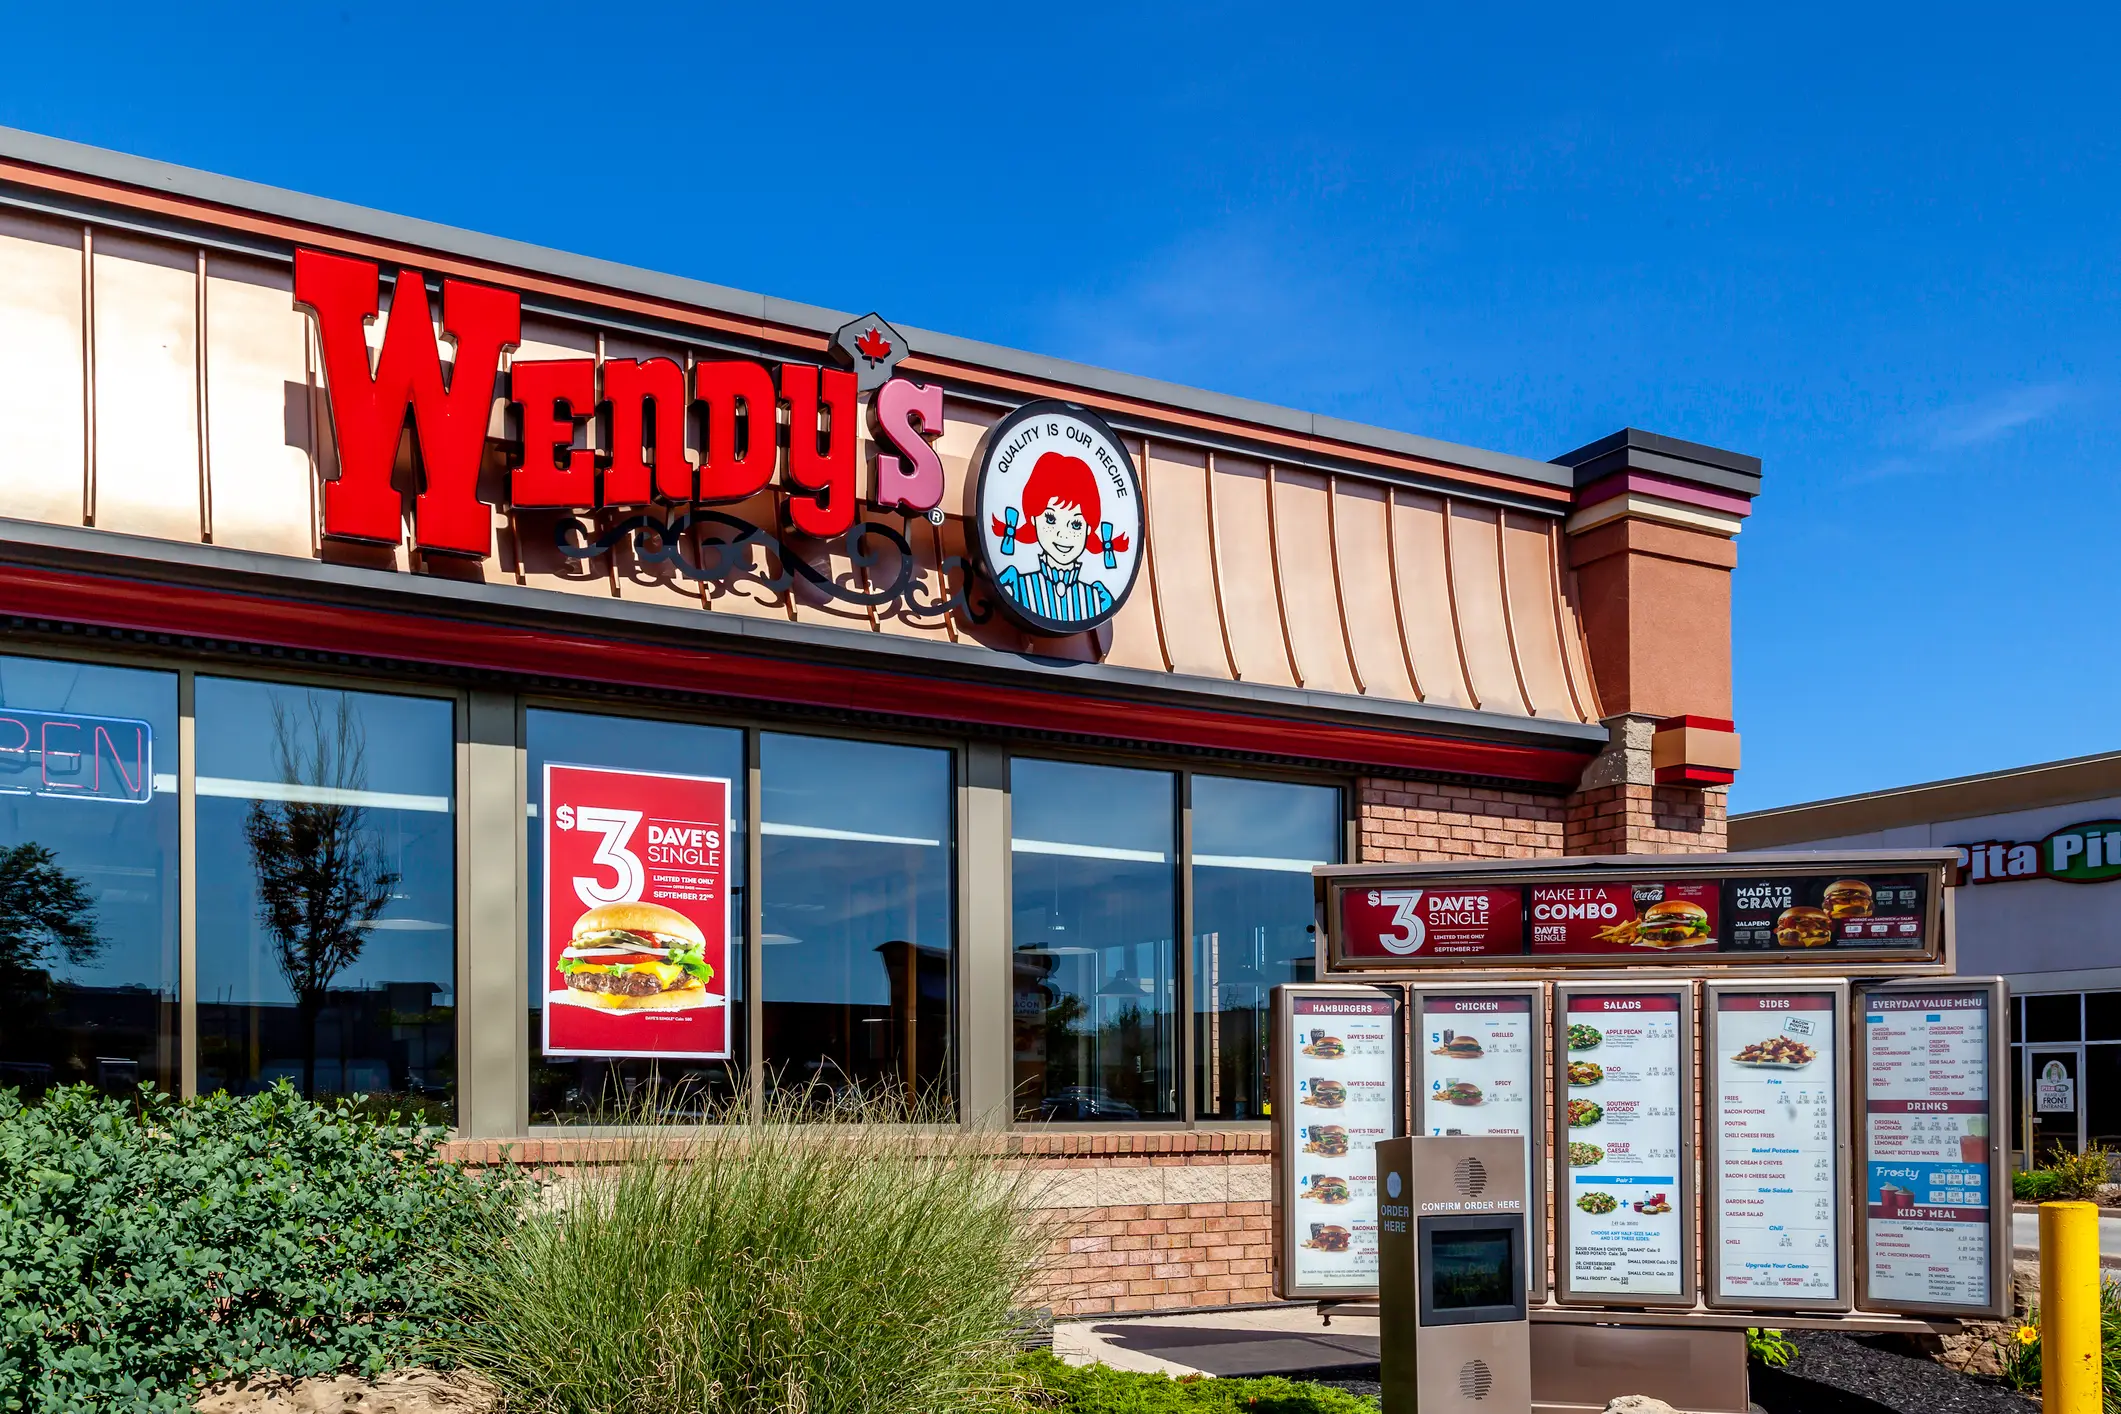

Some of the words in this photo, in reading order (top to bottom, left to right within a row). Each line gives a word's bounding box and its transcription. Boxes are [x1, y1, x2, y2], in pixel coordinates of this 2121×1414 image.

[998, 426, 1041, 473] QUALITY
[1046, 423, 1059, 437] IS
[1066, 425, 1093, 449] OUR
[1095, 446, 1128, 499] RECIPE
[648, 826, 720, 849] DAVE'S
[648, 846, 720, 867] SINGLE
[653, 875, 681, 883] LIMITED
[653, 890, 698, 900] SEPTEMBER
[1534, 889, 1576, 901] MAKE
[1578, 888, 1593, 900] IT
[1595, 888, 1608, 900] A
[1736, 887, 1775, 897] MADE
[1777, 886, 1792, 895] TO
[1428, 895, 1490, 912] DAVE'S
[1736, 896, 1792, 909] CRAVE
[1534, 902, 1618, 920] COMBO
[1428, 911, 1489, 926] SINGLE
[1534, 926, 1567, 934] DAVE'S
[1534, 934, 1567, 942] SINGLE
[1312, 1004, 1373, 1013] HAMBURGERS
[1454, 1002, 1498, 1011] CHICKEN
[1603, 1001, 1642, 1010] SALADS
[1759, 1000, 1790, 1008] SIDES
[1872, 1000, 1921, 1009] EVERYDAY
[1922, 999, 1952, 1008] VALUE
[1954, 998, 1982, 1007] MENU
[1299, 1034, 1306, 1044] 1
[1432, 1033, 1440, 1043] 5
[1300, 1081, 1307, 1091] 2
[1433, 1080, 1441, 1090] 6
[1907, 1102, 1948, 1111] DRINKS
[1300, 1128, 1307, 1138] 3
[1433, 1128, 1440, 1136] 7
[1876, 1166, 1920, 1180] Frosty
[1301, 1176, 1307, 1186] 4
[1381, 1204, 1409, 1217] ORDER
[1421, 1202, 1461, 1211] CONFIRM
[1464, 1201, 1494, 1210] ORDER
[1497, 1200, 1520, 1209] HERE
[1897, 1208, 1927, 1217] KIDS'
[1929, 1209, 1956, 1218] MEAL
[1384, 1220, 1406, 1232] HERE
